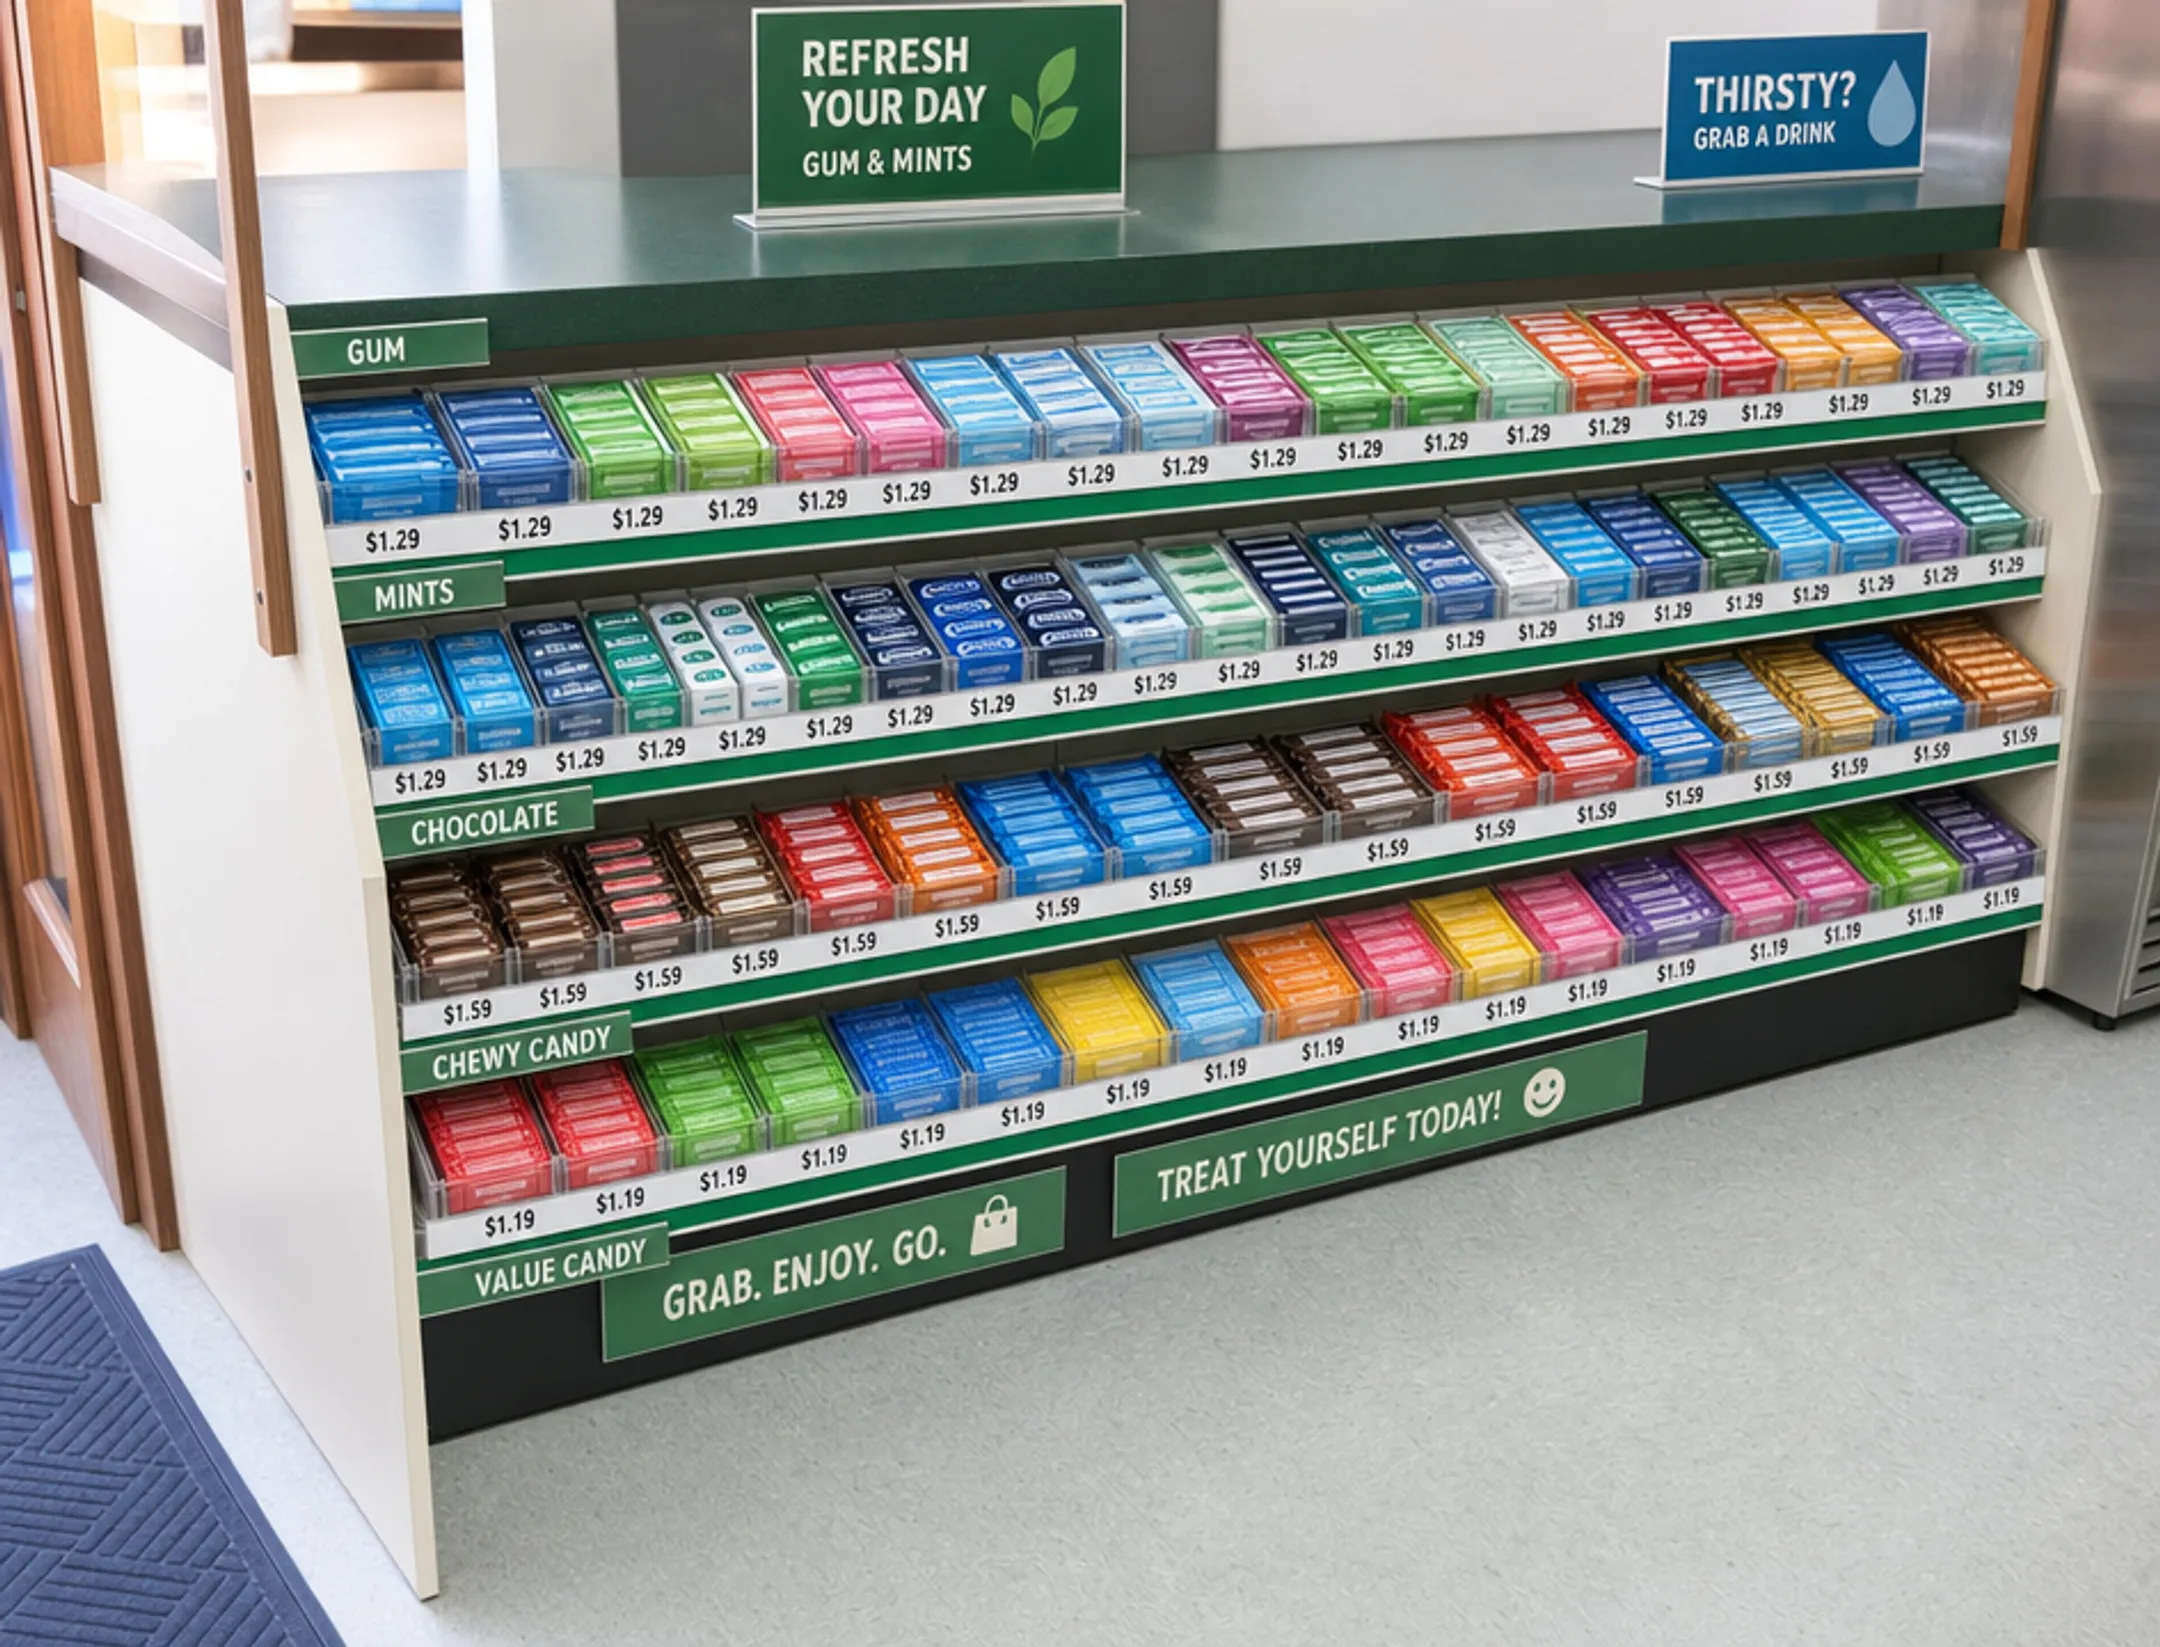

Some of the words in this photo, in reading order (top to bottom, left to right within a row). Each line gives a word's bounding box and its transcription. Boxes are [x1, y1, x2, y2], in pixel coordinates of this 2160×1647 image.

[802, 36, 969, 77] REFRESH
[1694, 70, 1856, 114] THIRSTY?
[801, 88, 903, 128] YOUR
[915, 84, 987, 125] DAY
[1694, 125, 1750, 150] GRAB
[1755, 124, 1769, 146] A
[1775, 121, 1836, 146] DRINK
[802, 149, 860, 178] GUM
[867, 148, 885, 175] &
[892, 144, 972, 173] MINTS
[347, 335, 405, 366] GUM
[1912, 386, 1951, 406] $1.29
[1986, 379, 2025, 400] $1.29
[1741, 401, 1784, 423] $1.29
[1829, 393, 1869, 414] $1.29
[1588, 416, 1631, 437] $1.29
[1665, 408, 1708, 430] $1.29
[1424, 431, 1469, 454] $1.29
[1507, 423, 1551, 446] $1.29
[1250, 447, 1297, 470] $1.29
[1338, 439, 1383, 462] $1.29
[1068, 463, 1115, 487] $1.29
[1162, 455, 1209, 478] $1.29
[883, 480, 931, 505] $1.29
[970, 471, 1019, 496] $1.29
[708, 496, 758, 521] $1.29
[798, 488, 848, 512] $1.29
[498, 515, 551, 542] $1.29
[612, 505, 663, 530] $1.29
[366, 528, 420, 554] $1.29
[1924, 565, 1959, 586] $1.29
[1989, 555, 2024, 576] $1.29
[375, 577, 455, 613] MINTS
[1793, 583, 1830, 605] $1.29
[1858, 574, 1895, 596] $1.29
[1654, 601, 1692, 623] $1.29
[1726, 592, 1763, 613] $1.29
[1518, 619, 1557, 642] $1.29
[1587, 610, 1625, 632] $1.29
[1373, 639, 1414, 662] $1.29
[1446, 629, 1485, 652] $1.29
[1218, 660, 1260, 683] $1.29
[1296, 649, 1338, 673] $1.29
[1053, 681, 1098, 706] $1.29
[1134, 672, 1177, 695] $1.29
[887, 704, 933, 729] $1.29
[970, 693, 1015, 717] $1.29
[719, 726, 766, 751] $1.29
[807, 714, 853, 739] $1.29
[2002, 725, 2038, 747] $1.59
[556, 747, 605, 773] $1.29
[638, 736, 686, 762] $1.29
[1914, 741, 1951, 764] $1.59
[477, 757, 527, 784] $1.29
[1831, 757, 1869, 779] $1.59
[395, 768, 446, 795] $1.29
[1754, 770, 1792, 793] $1.59
[1665, 785, 1704, 808] $1.59
[411, 801, 558, 846] CHOCOLATE
[1577, 800, 1617, 824] $1.59
[1475, 818, 1516, 843] $1.59
[1367, 837, 1409, 862] $1.59
[1260, 857, 1302, 881] $1.59
[1149, 876, 1192, 901] $1.59
[1983, 886, 2020, 910] $1.19
[1036, 896, 1080, 922] $1.59
[1907, 903, 1944, 926] $1.19
[935, 913, 979, 939] $1.59
[1824, 921, 1862, 945] $1.19
[831, 931, 877, 957] $1.59
[1750, 937, 1788, 962] $1.19
[732, 948, 779, 975] $1.59
[1657, 958, 1695, 983] $1.19
[634, 965, 682, 992] $1.59
[1568, 978, 1608, 1003] $1.19
[539, 982, 587, 1009] $1.59
[1484, 995, 1526, 1021] $1.19
[443, 998, 492, 1026] $1.59
[1398, 1015, 1439, 1041] $1.19
[432, 1041, 522, 1081] CHEWY
[528, 1024, 612, 1064] CANDY
[1302, 1036, 1345, 1062] $1.19
[1205, 1057, 1247, 1084] $1.19
[1105, 1078, 1150, 1105] $1.19
[1001, 1101, 1045, 1127] $1.19
[900, 1123, 945, 1150] $1.19
[1157, 1150, 1248, 1203] TREAT
[1257, 1114, 1398, 1178] YOURSELF
[1405, 1089, 1502, 1142] TODAY!
[801, 1143, 847, 1171] $1.19
[700, 1164, 747, 1193] $1.19
[596, 1187, 645, 1215] $1.19
[485, 1208, 535, 1238] $1.19
[474, 1257, 556, 1297] VALUE
[562, 1237, 647, 1280] CANDY
[663, 1268, 762, 1321] GRAB.
[773, 1238, 879, 1296] ENJOY.
[892, 1224, 947, 1266] GO.
